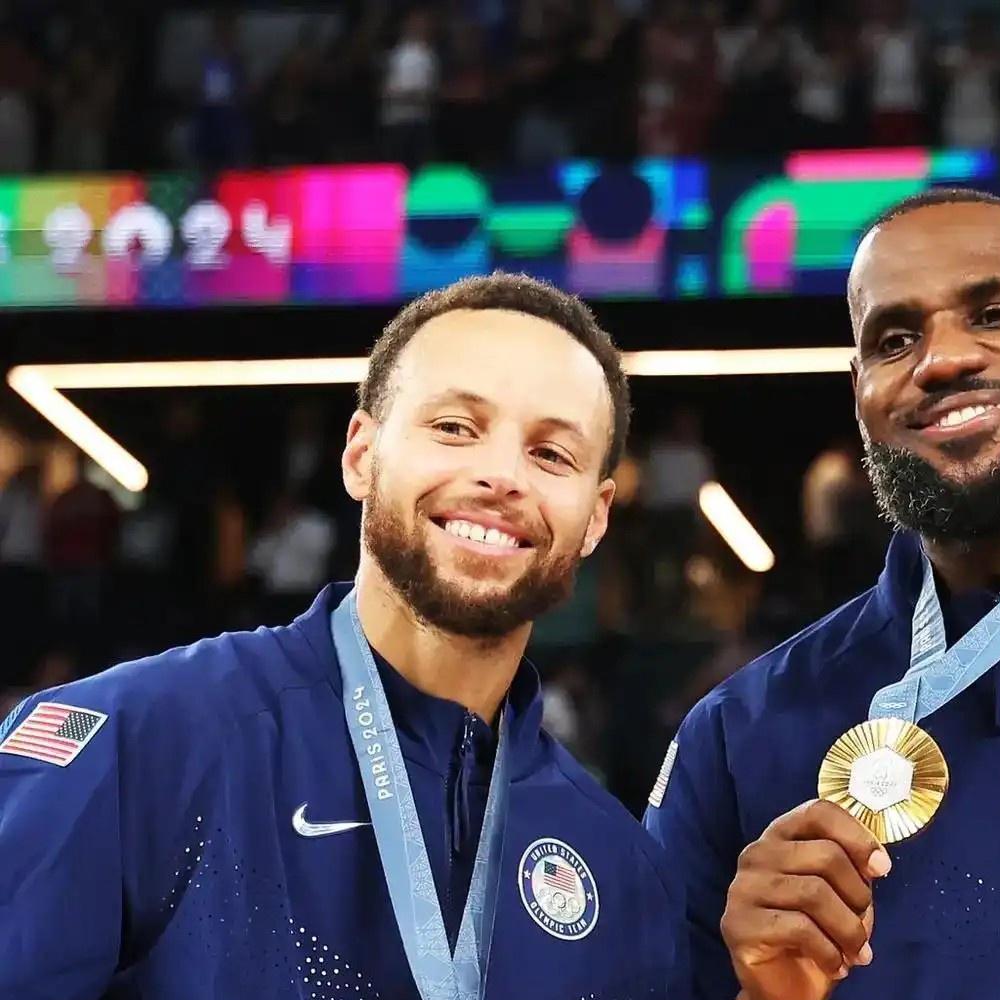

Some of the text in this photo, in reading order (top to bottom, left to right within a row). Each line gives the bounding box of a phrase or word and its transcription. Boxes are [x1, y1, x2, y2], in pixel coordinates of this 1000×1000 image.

[43, 199, 292, 275] 2024
[353, 685, 394, 801] PARIS 2024
[530, 844, 587, 879] UNITED STATES
[530, 901, 588, 934] OLYMPIC TEAM
